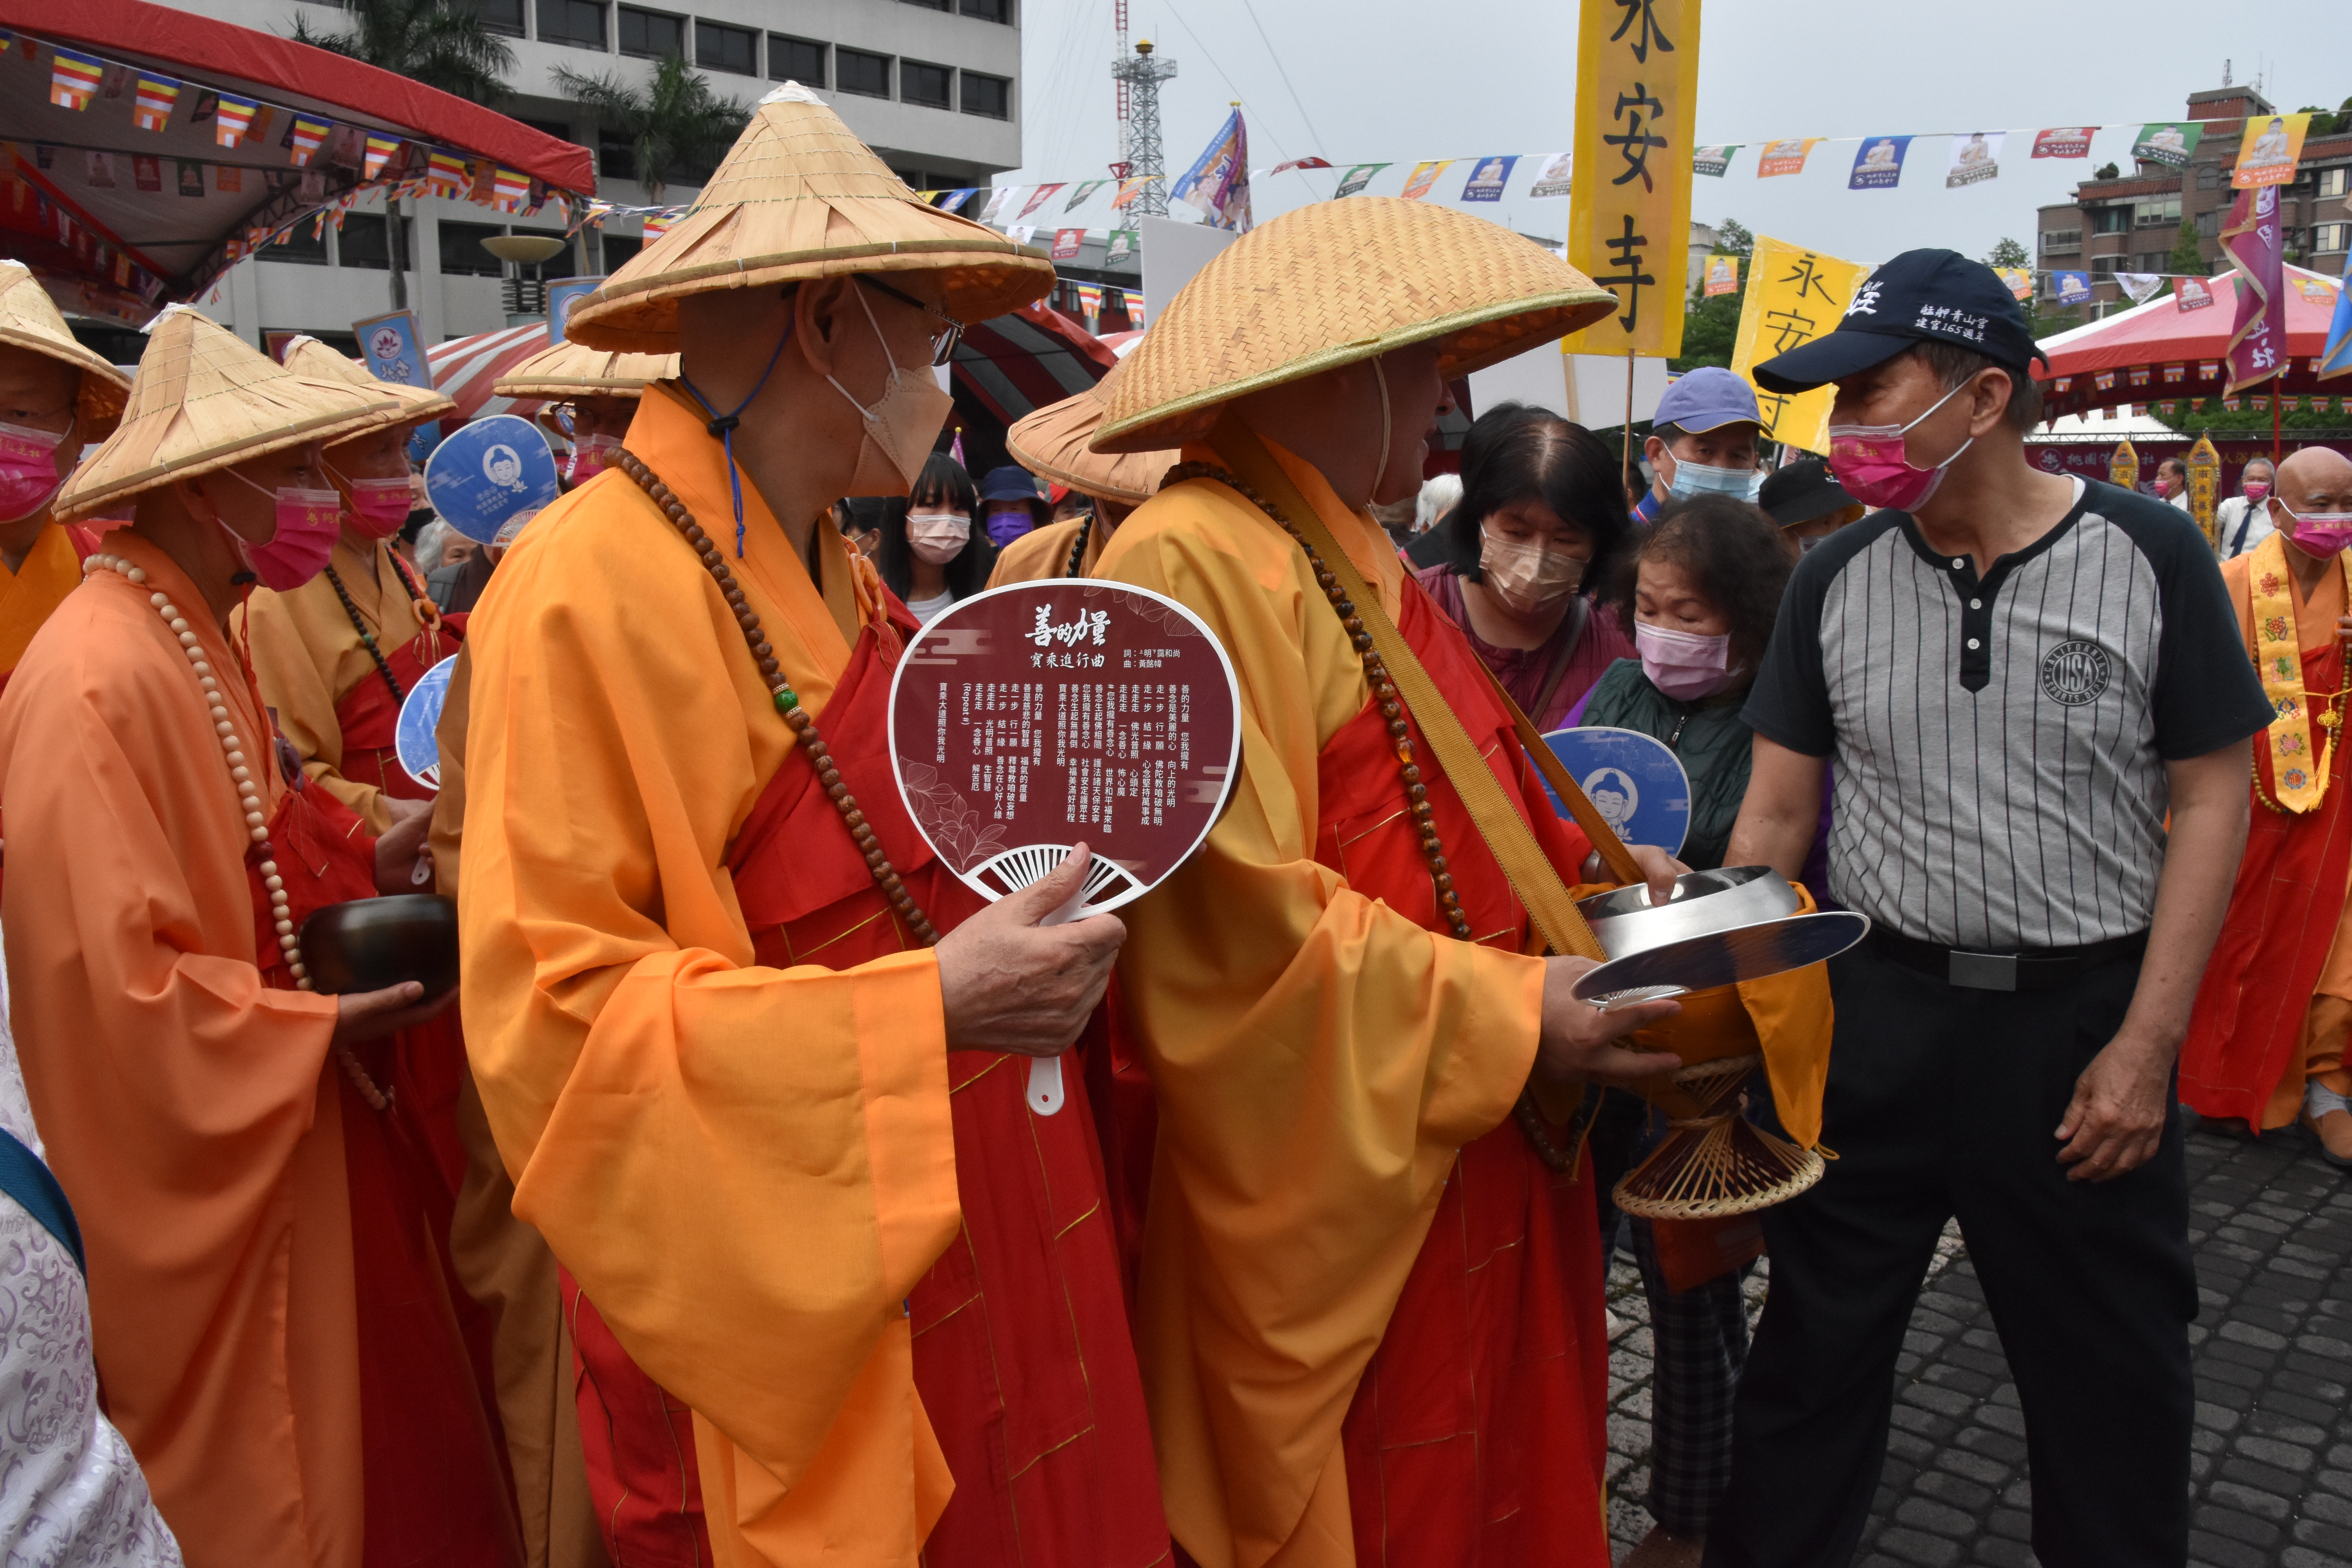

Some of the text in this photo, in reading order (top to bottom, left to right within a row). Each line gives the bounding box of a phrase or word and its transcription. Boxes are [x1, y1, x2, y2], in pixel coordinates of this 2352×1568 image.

[1915, 317, 1984, 343] 建宮165週年
[1920, 304, 1989, 329] 艋舺青山宮
[2067, 451, 2155, 470] 桃園佛社
[1025, 603, 1112, 648] 善的力量
[1030, 652, 1105, 668] 寶乘進行曲
[2044, 643, 2106, 672] CALIFORNIA
[961, 683, 971, 726] (Repeat #)
[2060, 654, 2093, 692] USA
[936, 682, 947, 763] 寶乘大道照你我光明
[971, 683, 983, 791] 走走走 一念善心 解苦厄
[983, 683, 996, 791] 走走走 光明普照 生智慧
[994, 683, 1007, 819] 走一步 結一緣 善念在心好人緣
[1006, 683, 1019, 820] 走一步 行一願 釋尊教咱破妄想
[1019, 684, 1031, 802] 善是慈悲的智慧 福氣的度量
[1033, 684, 1043, 766] 善的力量 您我攏有
[1057, 684, 1067, 767] 寶乘大道照你我光明
[1067, 684, 1079, 822] 善念生起無顛倒 幸福美滿好前程
[1079, 684, 1091, 823] 您我攏有善念心 社會安定護眾生
[1092, 684, 1103, 823] 善念生起佛相隨 護法諸天保安寧
[1117, 684, 1127, 797] 走走走 一念善心 怖心魔
[1131, 722, 1139, 759] 佛光普照
[1141, 684, 1152, 825] 走一步 結一緣 心念堅持萬事成
[1154, 684, 1164, 826] 走一步 行一願 佛陀教咱破無明
[1167, 684, 1176, 808] 善念是美麗的心 向上的光明
[1181, 684, 1189, 770] 善的力量 您我攏有
[1103, 768, 1114, 833] 世界和平福來臨
[1129, 769, 1138, 797] 心頭定
